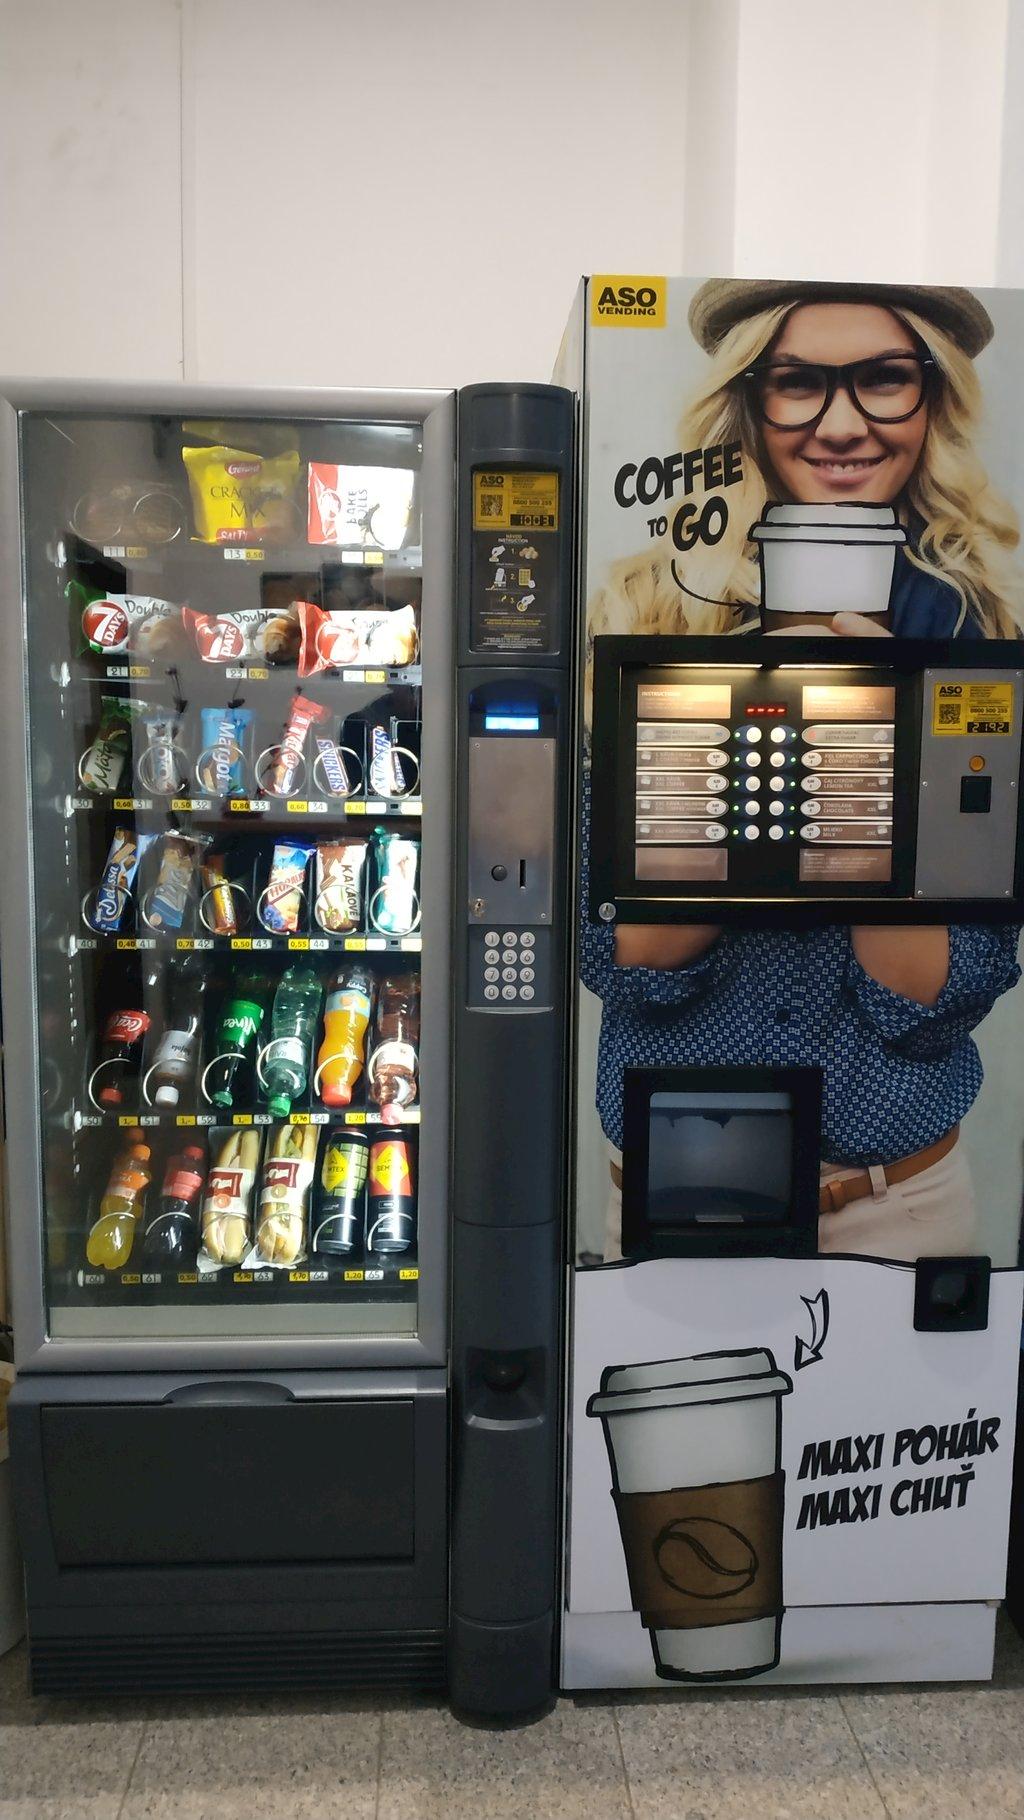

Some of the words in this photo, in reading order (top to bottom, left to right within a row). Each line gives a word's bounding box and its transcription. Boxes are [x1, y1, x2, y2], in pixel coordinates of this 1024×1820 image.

[598, 287, 657, 307] ASO
[598, 307, 656, 315] VENDING
[614, 441, 743, 508] COFFEE
[480, 475, 504, 484] ASO
[647, 516, 668, 537] TO
[672, 496, 728, 551] GO
[91, 606, 119, 642] 7
[104, 612, 126, 643] DAYS
[220, 625, 238, 657] DAYS
[939, 686, 963, 694] ASO
[973, 722, 1005, 733] 2192
[212, 721, 235, 785] Margot
[116, 801, 131, 809] 0,60
[174, 801, 191, 809] 0,50
[254, 801, 267, 810] 33
[311, 802, 324, 812] 34
[97, 865, 121, 922] Delssa
[118, 941, 135, 949] 0,40
[139, 940, 151, 949] 41
[178, 941, 195, 949] 0,70
[197, 940, 209, 949] 42
[233, 941, 250, 949] 0,50
[256, 940, 268, 948] 43
[313, 940, 325, 948] 44
[223, 1015, 257, 1036] Vinea
[201, 1116, 213, 1124] 52
[258, 1115, 270, 1123] 53
[315, 1115, 326, 1123] 54
[146, 1274, 158, 1283] 61
[201, 1273, 213, 1282] 62
[257, 1272, 270, 1281] 63
[313, 1272, 325, 1280] 64
[368, 1270, 380, 1279] 65
[401, 1270, 417, 1278] 1,20
[797, 1433, 885, 1480] MAXI
[893, 1408, 1001, 1467] POHÁR
[796, 1484, 883, 1530] MAXI
[890, 1463, 975, 1517] CHUŤ
